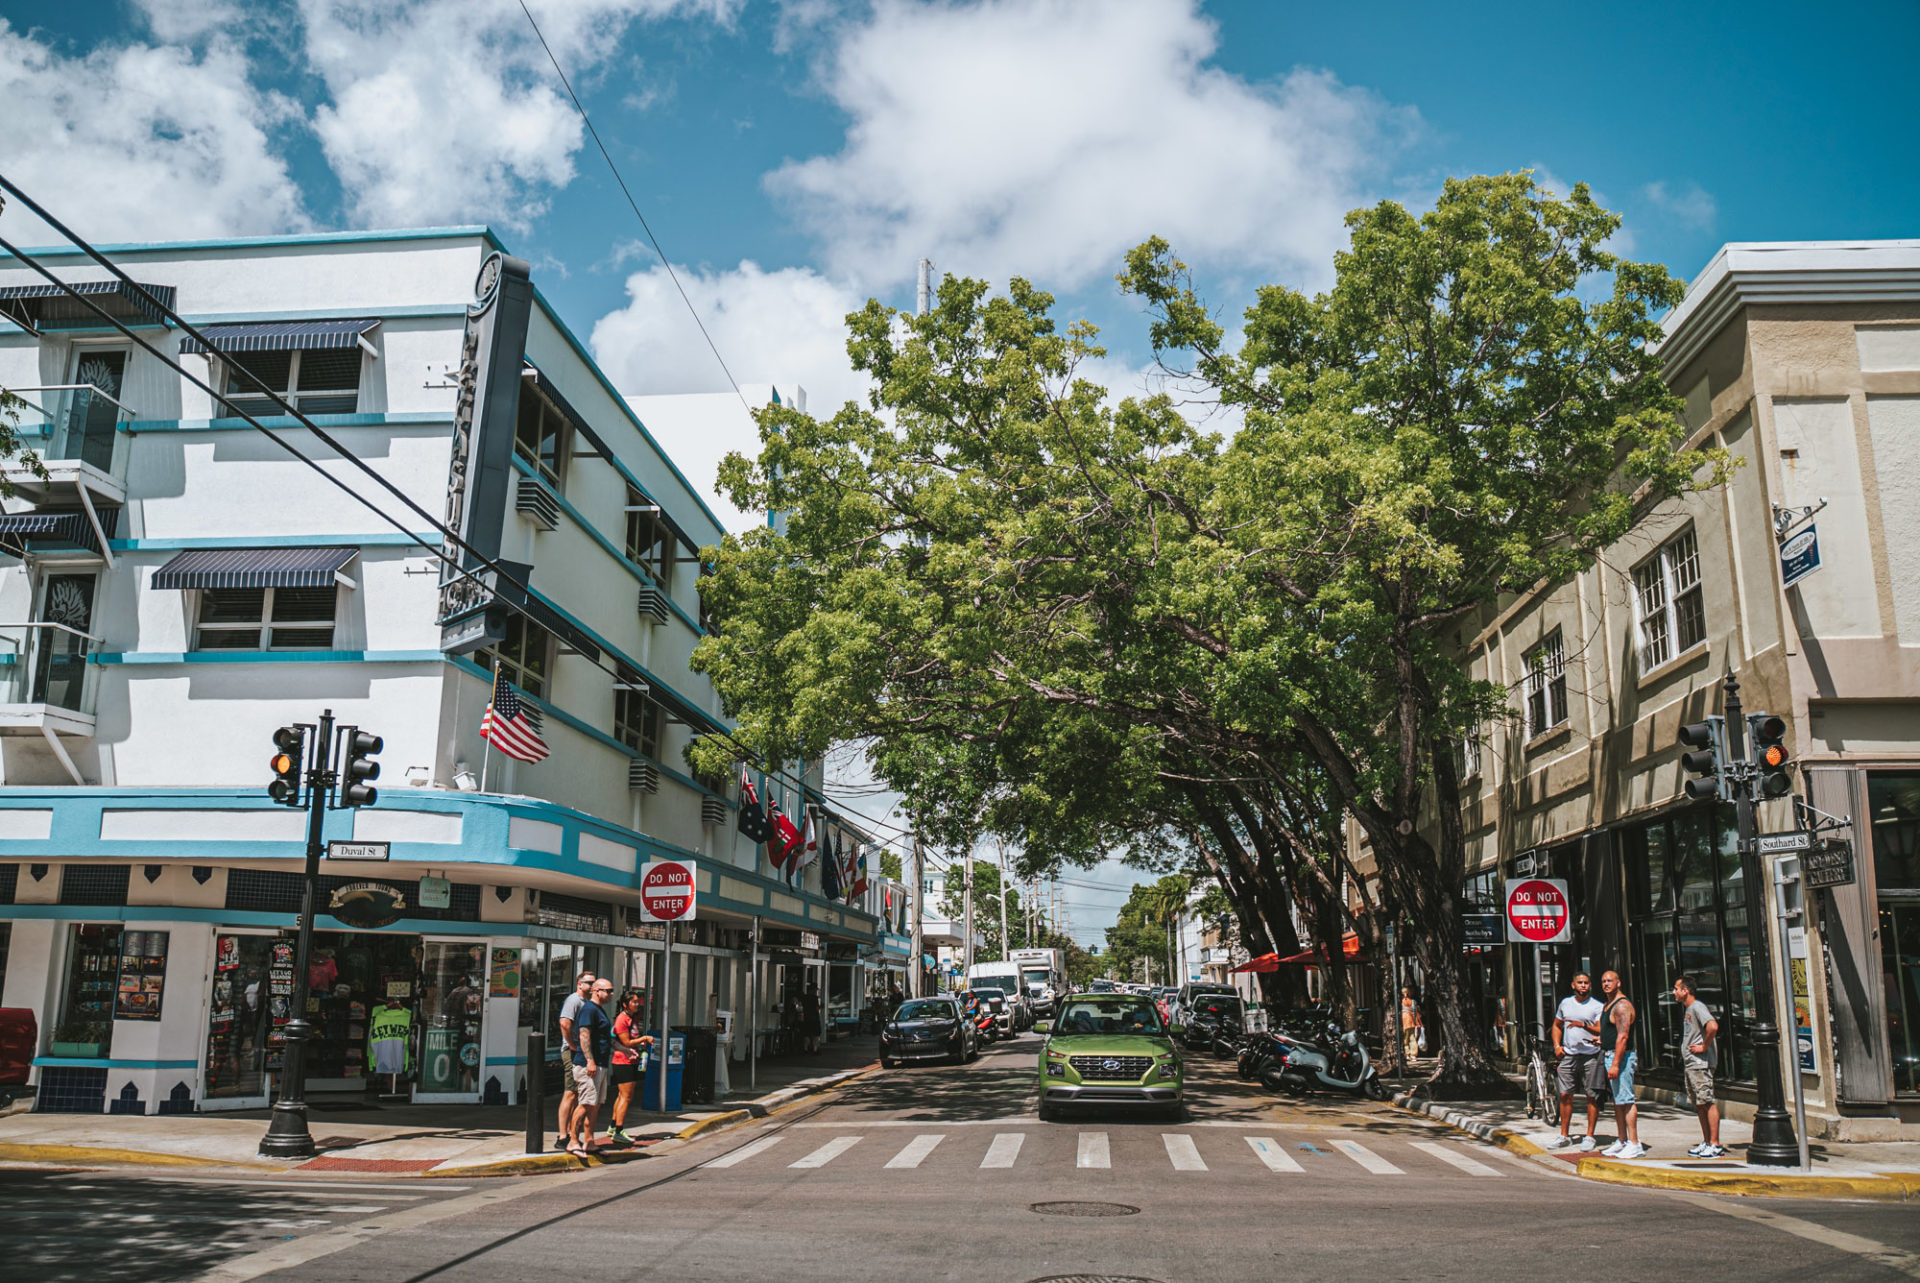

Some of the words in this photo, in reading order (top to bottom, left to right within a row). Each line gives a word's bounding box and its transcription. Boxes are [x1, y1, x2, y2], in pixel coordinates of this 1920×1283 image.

[1762, 837, 1796, 850] Southard
[1798, 836, 1806, 847] St
[340, 846, 366, 856] Duval
[367, 847, 376, 856] St
[650, 874, 663, 884] DO
[668, 872, 687, 883] NOT
[1516, 892, 1531, 902] DO
[1537, 892, 1558, 902] NOT
[653, 898, 684, 910] ENTER
[1521, 919, 1556, 930] ENTER
[429, 1033, 459, 1051] MILE
[433, 1053, 450, 1082] 0
